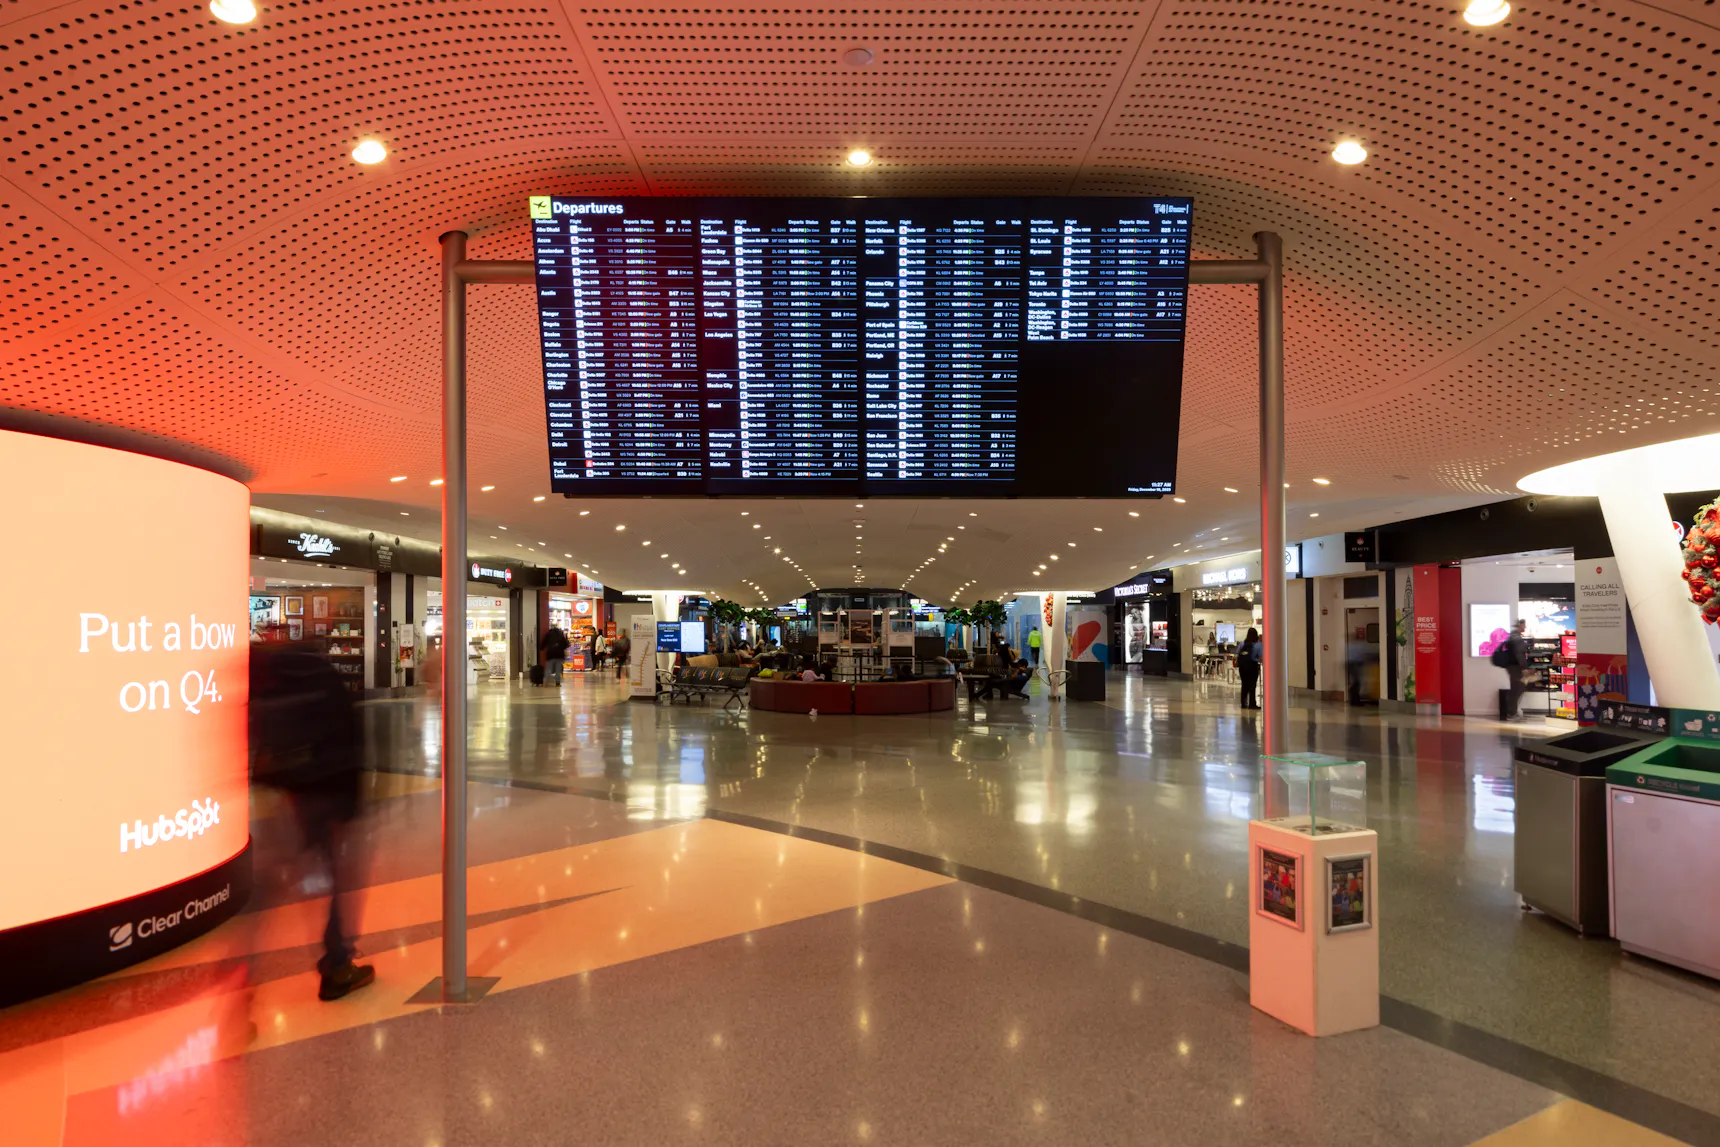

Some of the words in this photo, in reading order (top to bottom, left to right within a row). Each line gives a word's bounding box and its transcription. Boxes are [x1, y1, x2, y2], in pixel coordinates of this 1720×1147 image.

[552, 201, 624, 216] Departures
[1114, 585, 1135, 597] VICTORIA'S
[1134, 583, 1149, 594] SECRET
[78, 612, 152, 653] Put
[163, 621, 182, 651] a
[190, 613, 236, 650] bow
[119, 678, 170, 712] on
[180, 669, 223, 714] Q4.
[120, 797, 220, 853] HubSpot
[137, 910, 182, 938] Clear
[184, 883, 231, 920] Channel
